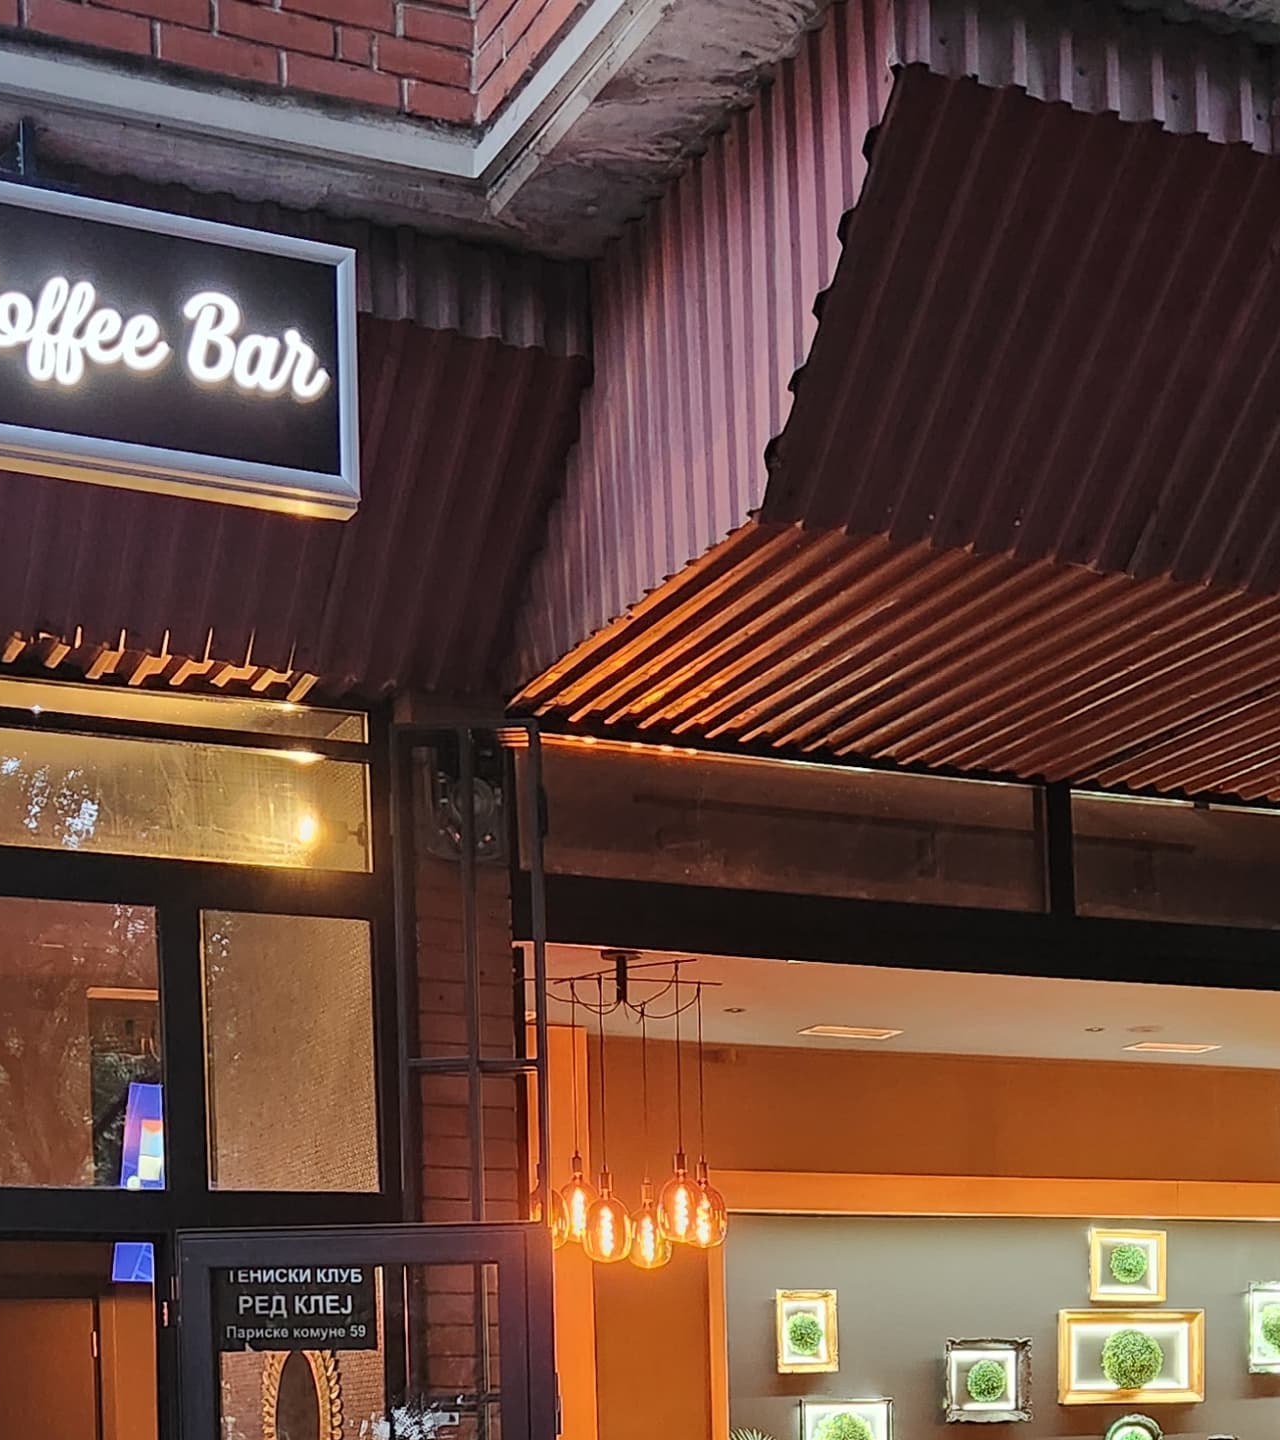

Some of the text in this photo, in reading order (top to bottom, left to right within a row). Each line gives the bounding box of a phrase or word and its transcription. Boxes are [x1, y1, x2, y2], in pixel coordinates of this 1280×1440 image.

[181, 290, 330, 399] Bar
[317, 1268, 363, 1283] КЛУБ
[239, 1295, 353, 1318] РЕД КЛЕЈ
[227, 1325, 366, 1341] Париске комуне 59
